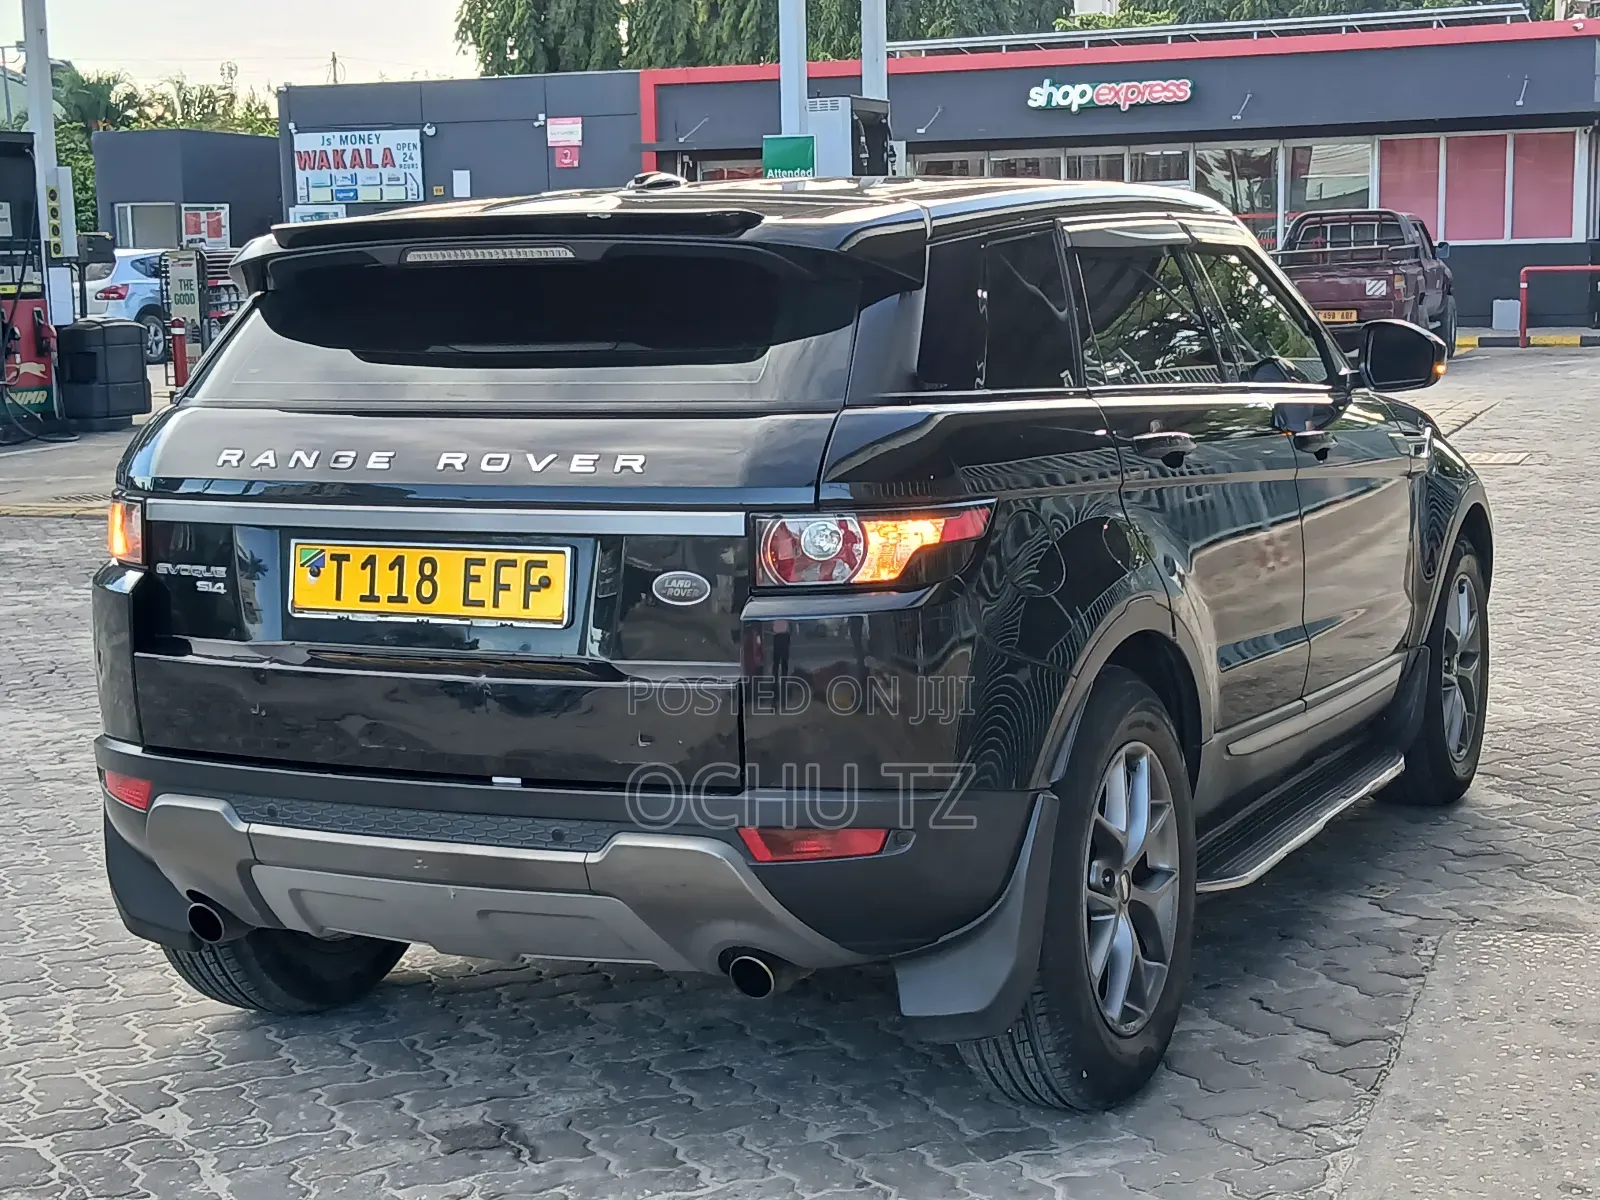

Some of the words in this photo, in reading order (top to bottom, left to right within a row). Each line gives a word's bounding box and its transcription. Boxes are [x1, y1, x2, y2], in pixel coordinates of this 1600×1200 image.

[1027, 78, 1093, 113] shop
[1093, 79, 1192, 112] express
[339, 133, 381, 146] MONEY
[396, 142, 418, 151] OPEN
[296, 147, 396, 171] WAKALA
[402, 152, 415, 163] 24
[766, 167, 813, 179] Attended
[178, 279, 194, 291] THE
[174, 293, 196, 305] GOOD
[216, 449, 397, 471] RANGE
[436, 452, 648, 474] ROVER
[156, 562, 227, 578] EVOQUE
[329, 553, 438, 605] T118
[462, 557, 550, 610] EFF
